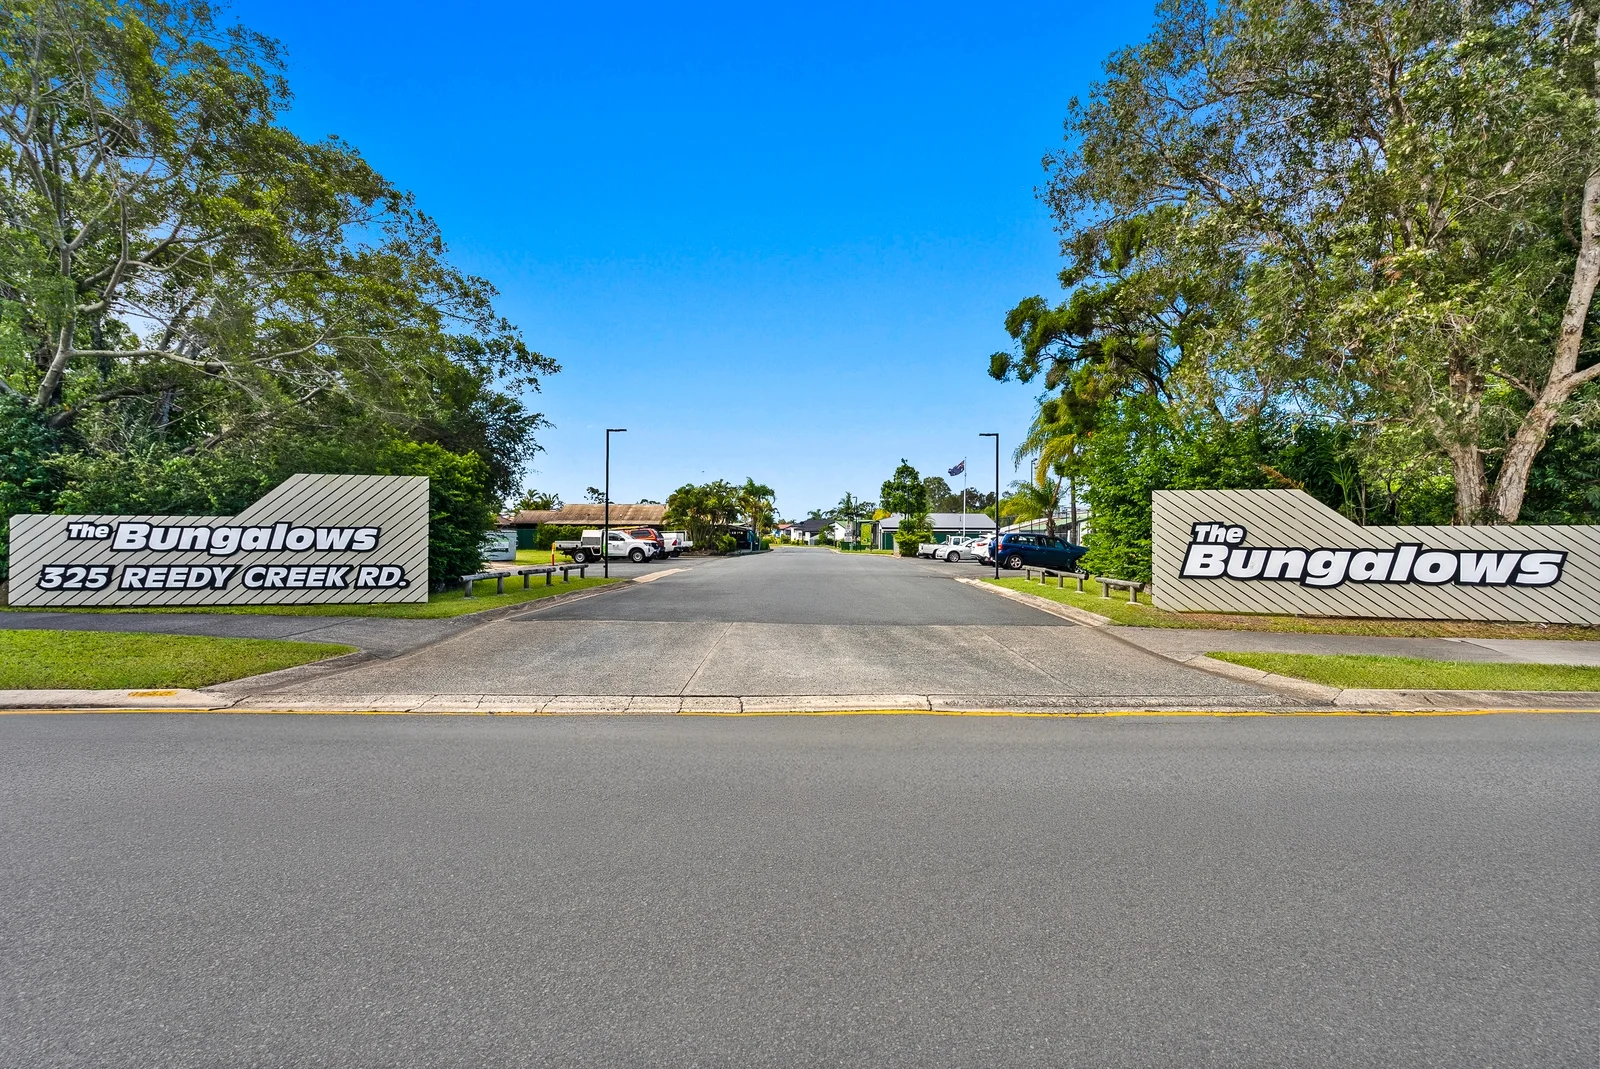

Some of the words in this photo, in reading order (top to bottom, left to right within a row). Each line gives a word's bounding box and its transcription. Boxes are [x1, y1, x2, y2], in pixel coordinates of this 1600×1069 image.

[67, 522, 111, 540] The
[112, 522, 379, 554] Bungalows
[1193, 523, 1244, 544] The
[39, 566, 111, 589] 325
[120, 566, 237, 589] REEDY
[244, 566, 352, 589] CREEK
[355, 566, 408, 588] RD.
[1181, 544, 1564, 586] Bungalows
